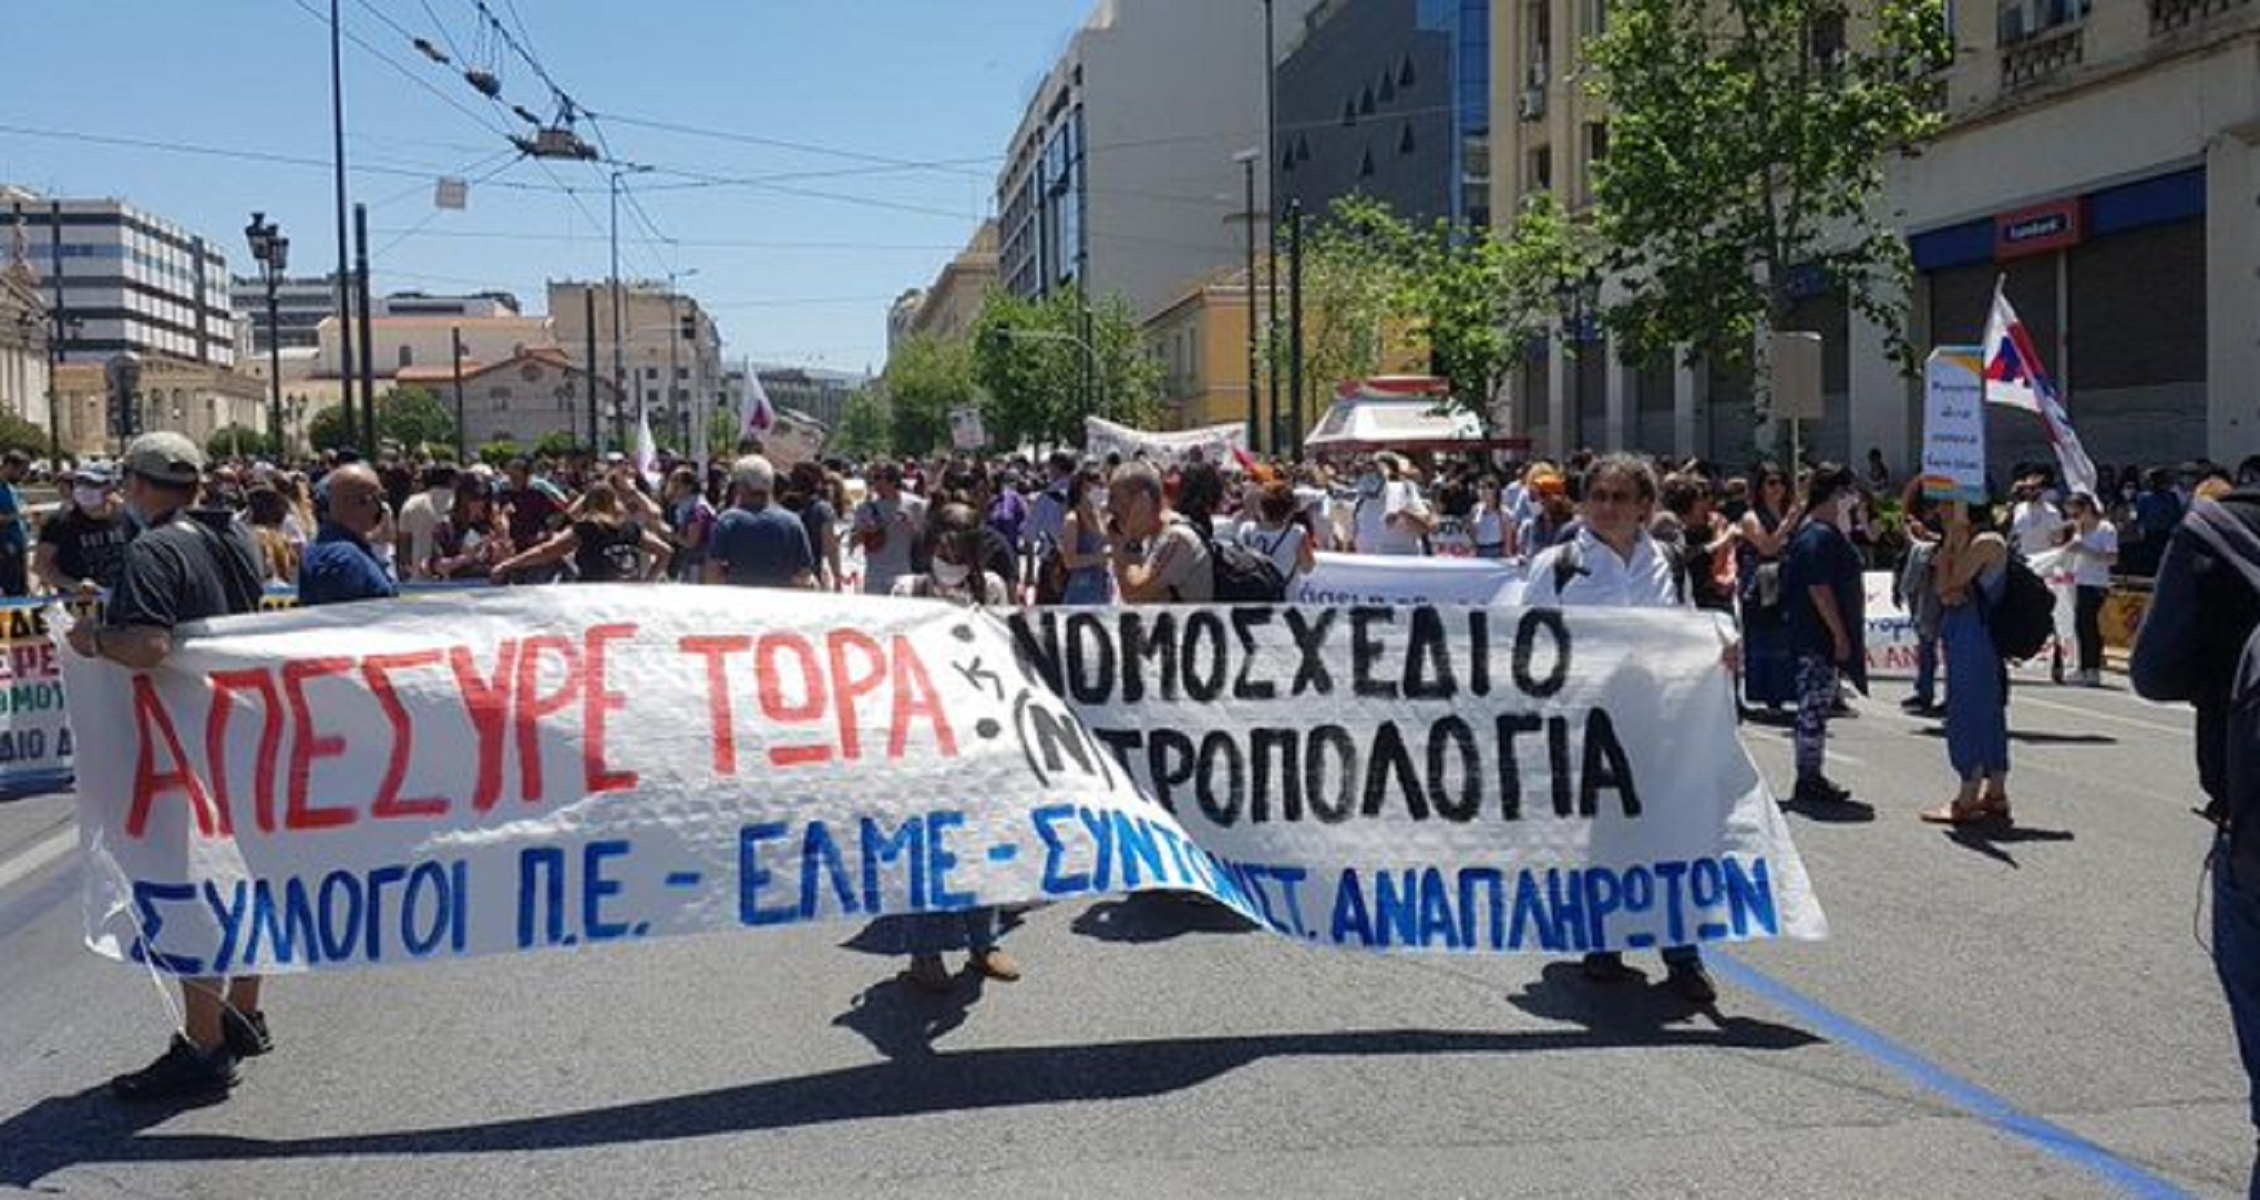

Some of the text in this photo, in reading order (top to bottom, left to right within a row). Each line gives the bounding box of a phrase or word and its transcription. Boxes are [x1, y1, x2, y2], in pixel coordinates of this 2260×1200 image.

[1008, 606, 1572, 706] ΝΟΜΟΣΧΕΔΙΟ
[126, 623, 957, 839] ΑΠΕΣΥΡΕ ΤΩΡΑ
[740, 812, 976, 926] ΕΛΜΕ
[1332, 856, 1779, 951] ΑΝΑΠΛΗΡΩΤΩΝ
